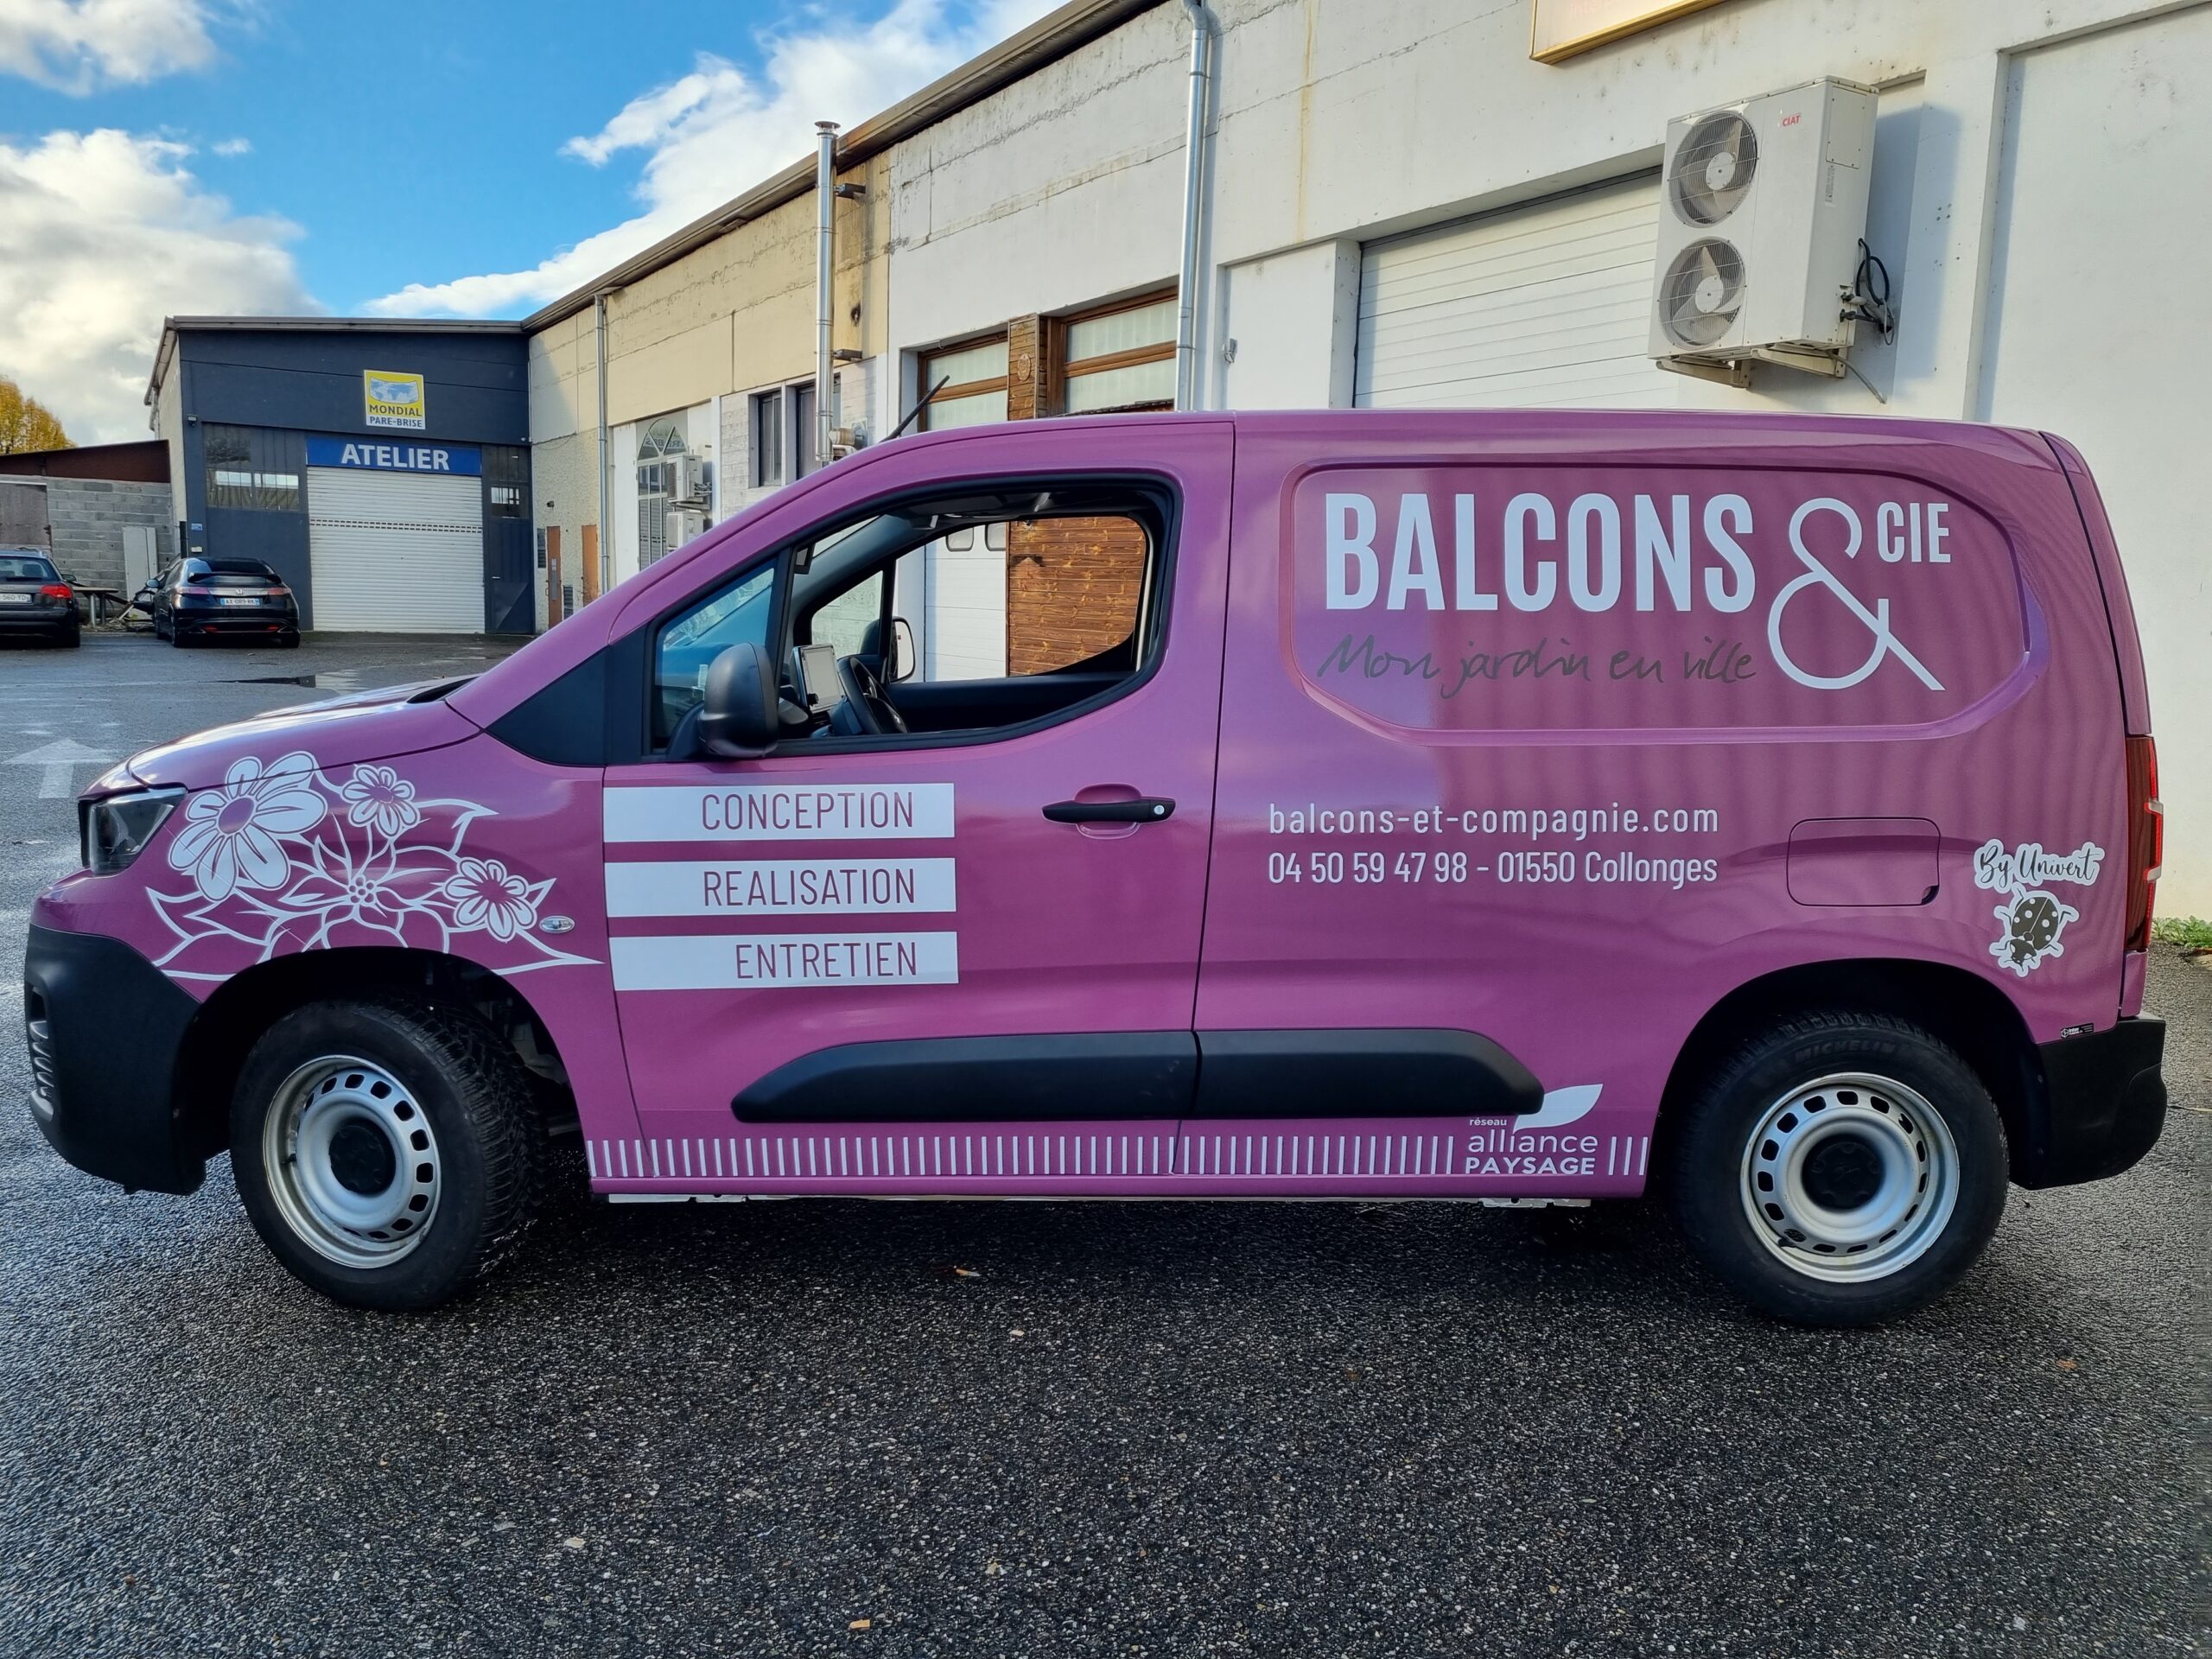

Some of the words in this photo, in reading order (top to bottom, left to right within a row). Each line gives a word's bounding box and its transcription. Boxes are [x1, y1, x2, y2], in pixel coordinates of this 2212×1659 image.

[1783, 114, 1802, 127] CIAT
[368, 404, 423, 417] MONDIAL
[369, 416, 423, 429] PARE-BRISE
[340, 443, 450, 471] ATELIER
[1325, 493, 1757, 613] BALCONS
[1768, 497, 1946, 691] &
[1876, 501, 1952, 564] CIE
[1317, 634, 1448, 681] Mon
[1440, 635, 1592, 700] jardin
[1609, 649, 1665, 683] en
[1681, 640, 1758, 685] ville
[701, 791, 914, 831] CONCEPTION
[1269, 802, 1719, 841] balcons-et-compagnie.com
[1268, 852, 1302, 884] 04
[1310, 852, 1344, 883] 50
[1352, 852, 1386, 883] 59
[1394, 852, 1427, 883] 47
[1433, 851, 1469, 882] 98
[1497, 851, 1577, 883] 01550
[1584, 850, 1719, 890] Collonges
[1979, 844, 2012, 888] By
[2018, 848, 2101, 882] Univert
[702, 868, 916, 907] REALISATION
[734, 941, 918, 980] ENTRETIEN
[1467, 1128, 1599, 1154] alliance
[1469, 1116, 1508, 1127] réseau
[1464, 1156, 1597, 1176] PAYSAGE
